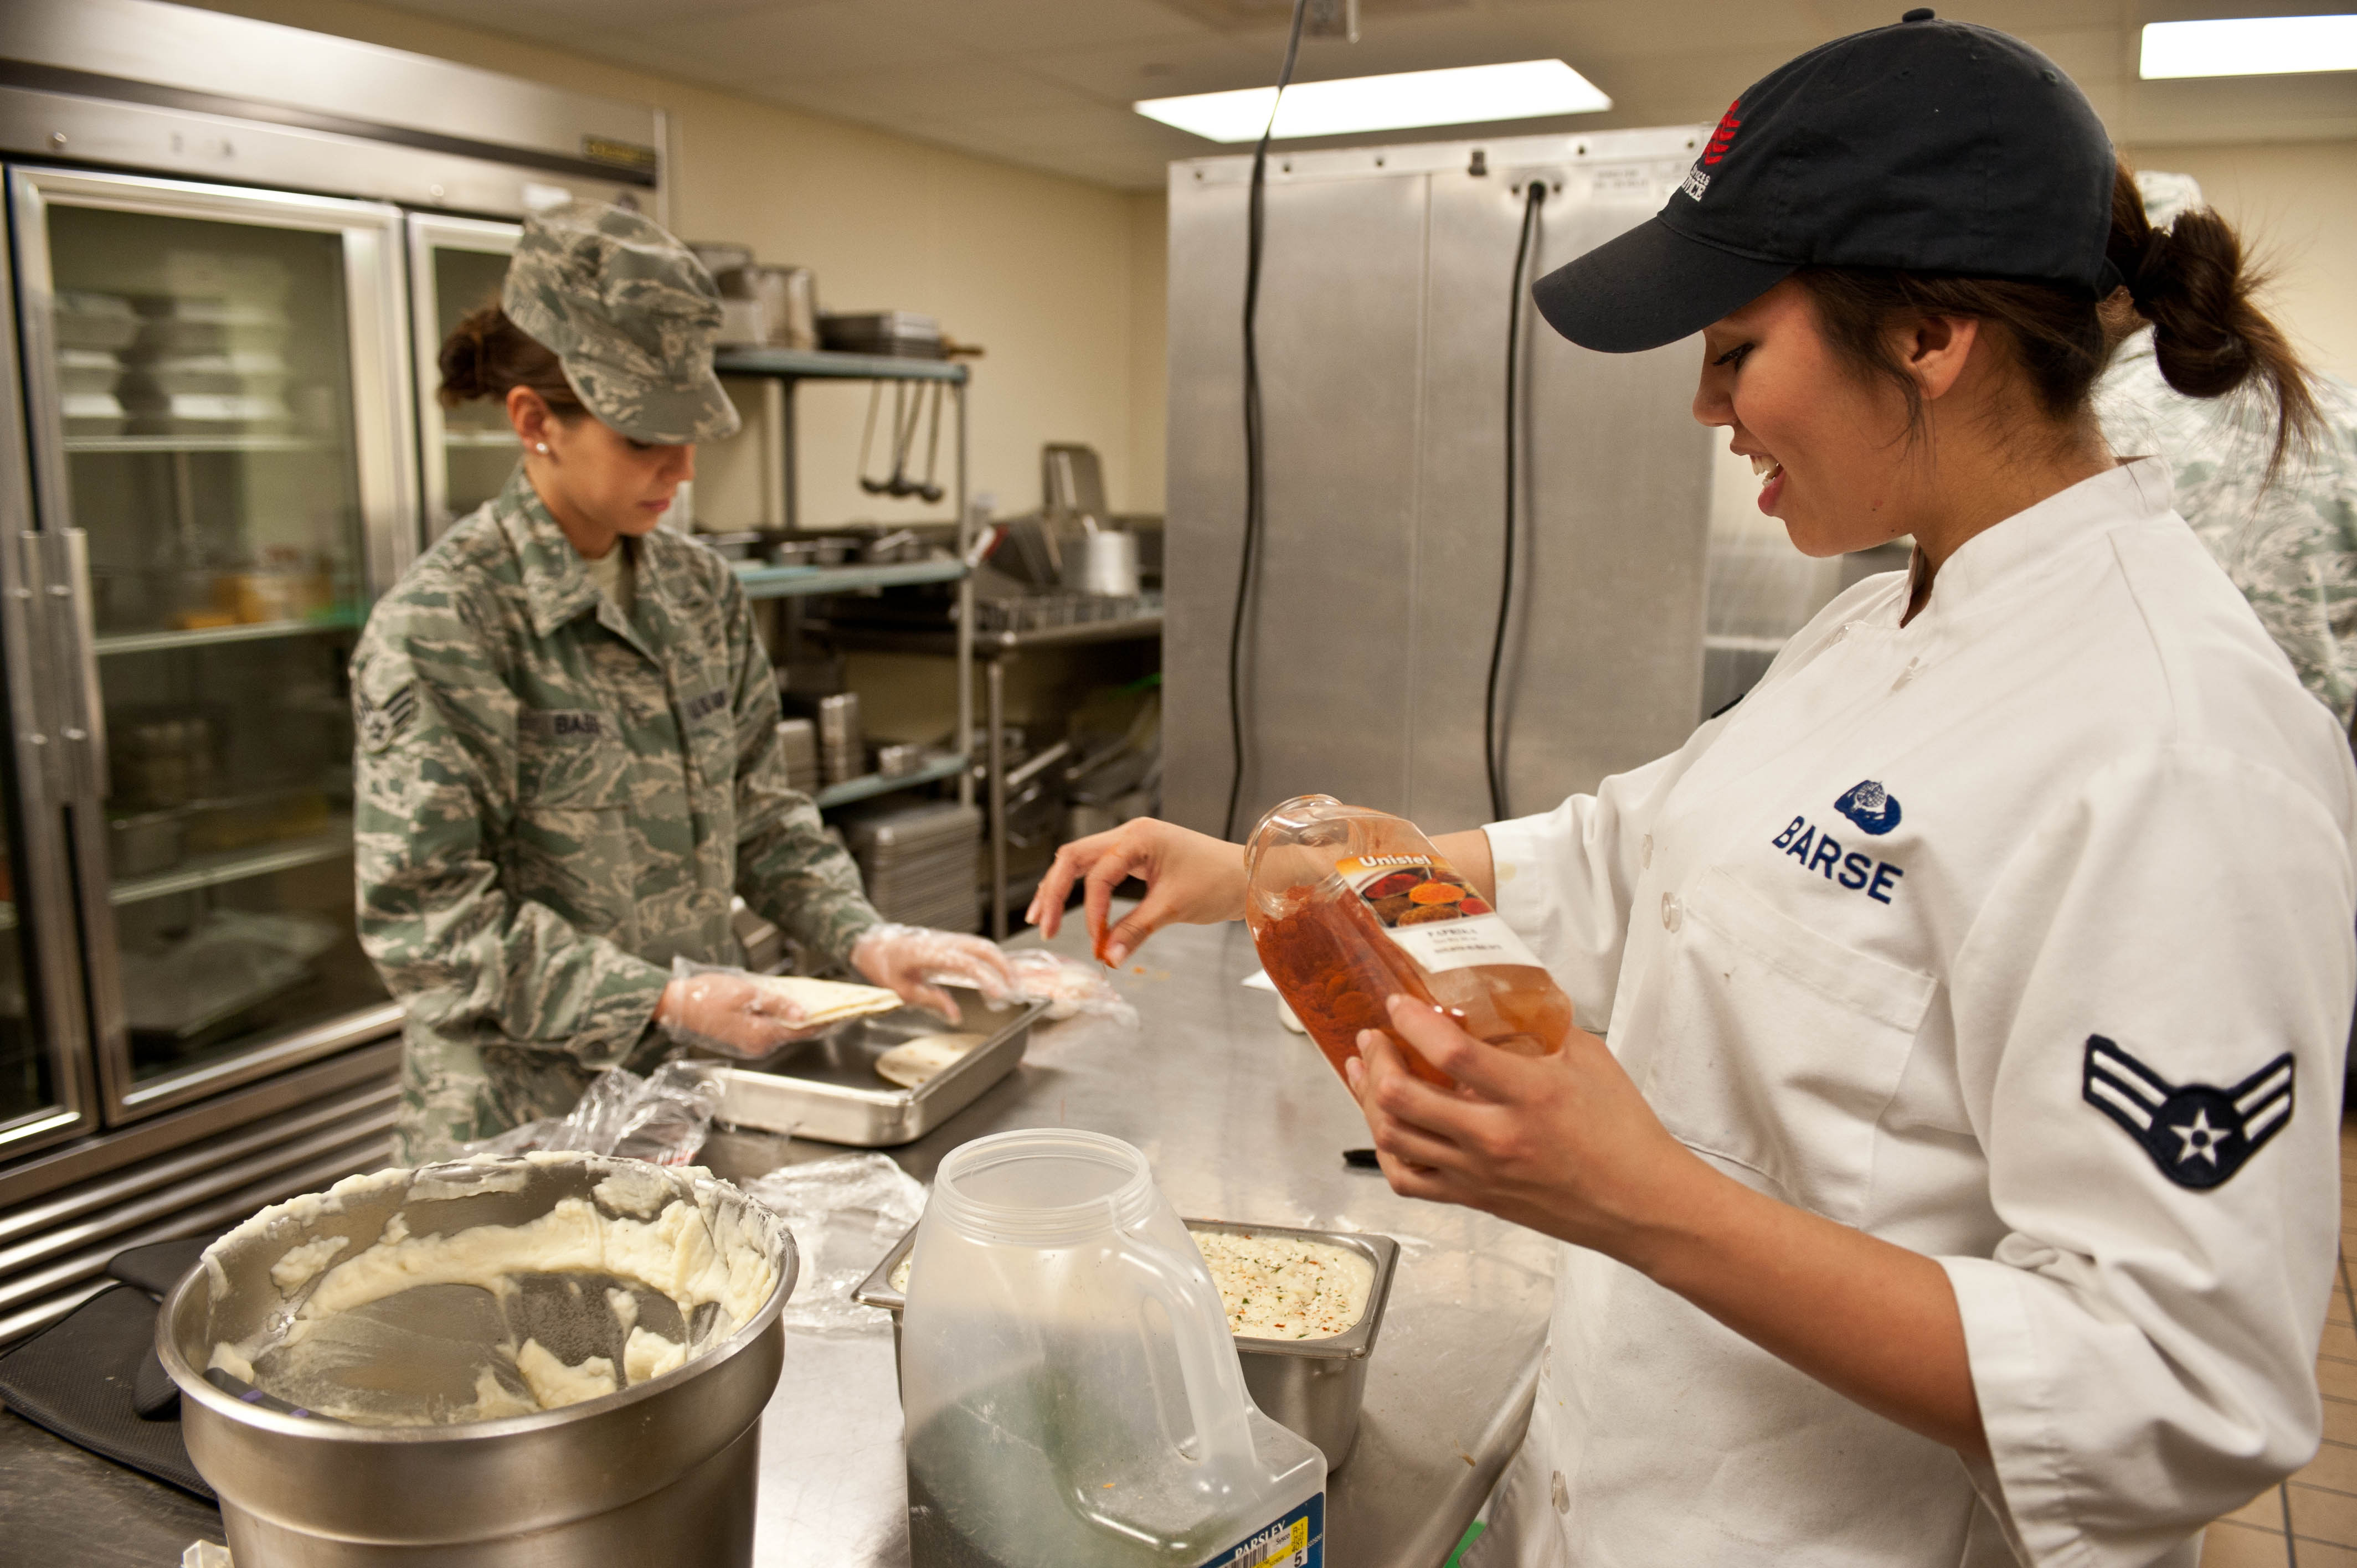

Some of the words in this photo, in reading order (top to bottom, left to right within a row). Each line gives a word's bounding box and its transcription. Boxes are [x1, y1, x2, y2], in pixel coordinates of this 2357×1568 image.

[1358, 854, 1432, 868] Unistel
[1772, 816, 1904, 905] BARSE
[1235, 1520, 1285, 1559] PARSLEY
[1294, 1550, 1303, 1567] 5
